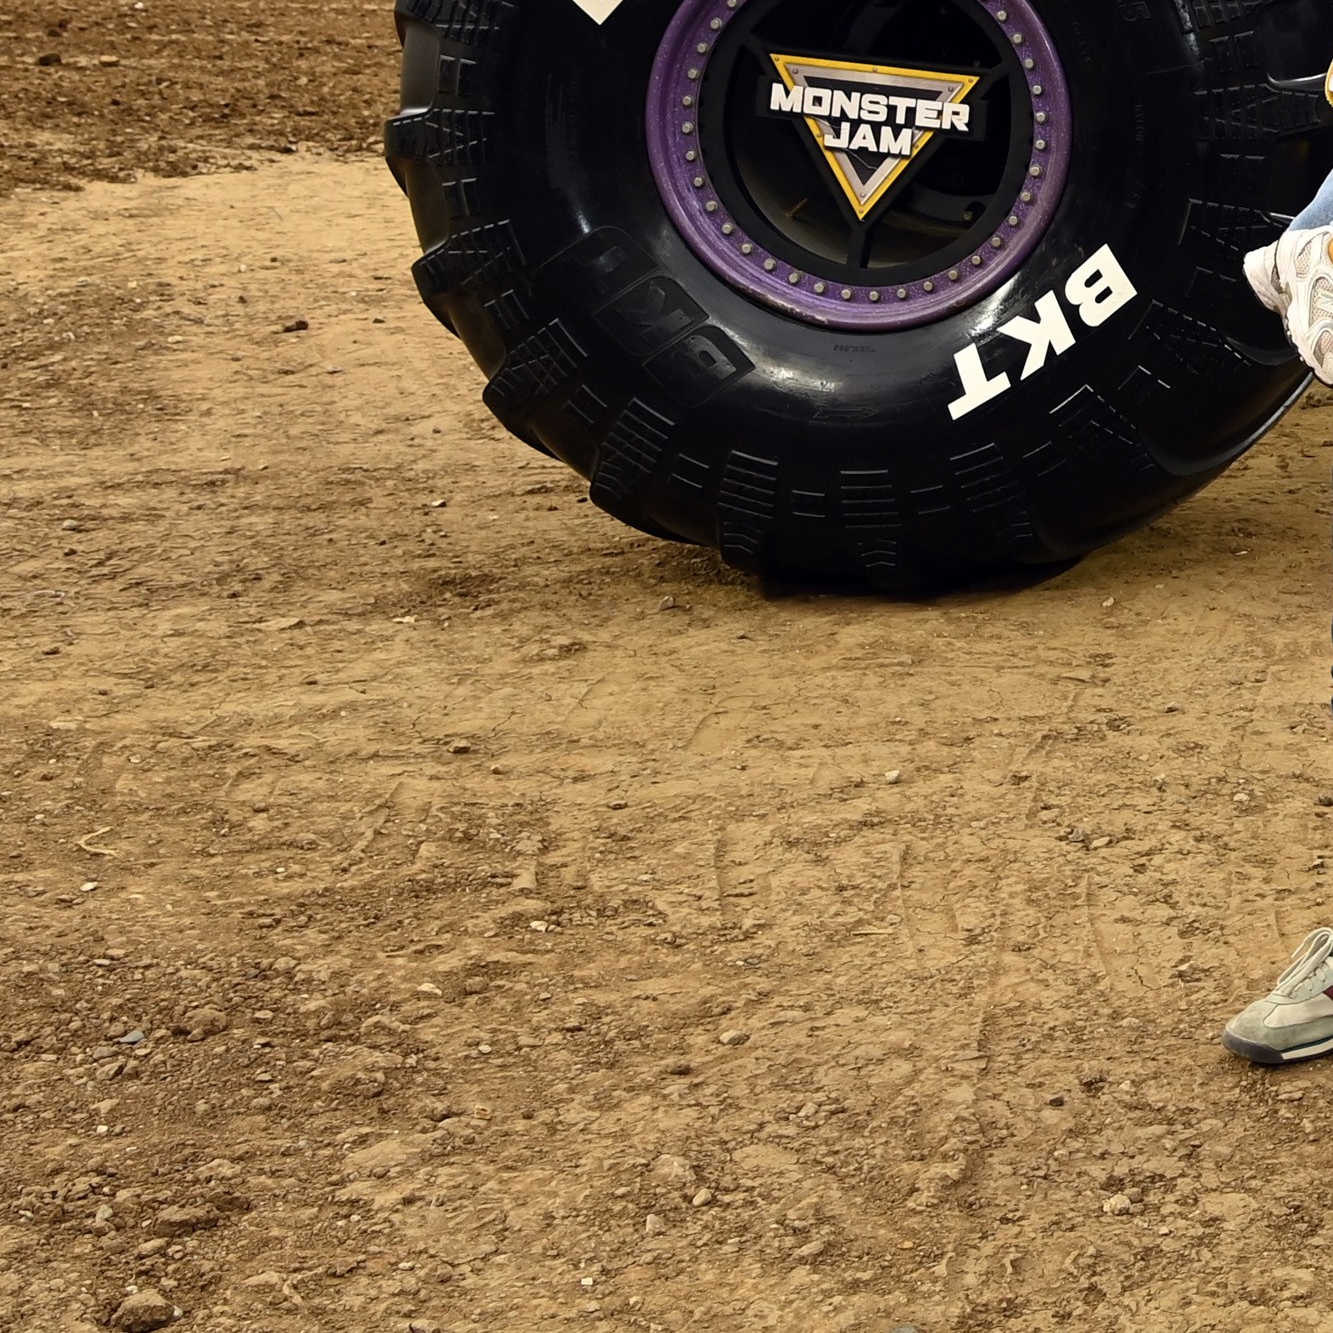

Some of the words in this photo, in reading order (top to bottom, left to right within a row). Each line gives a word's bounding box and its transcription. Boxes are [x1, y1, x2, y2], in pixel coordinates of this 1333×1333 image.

[770, 83, 970, 132] MONSTER
[823, 121, 913, 157] JAM
[947, 243, 1137, 420] BKT
